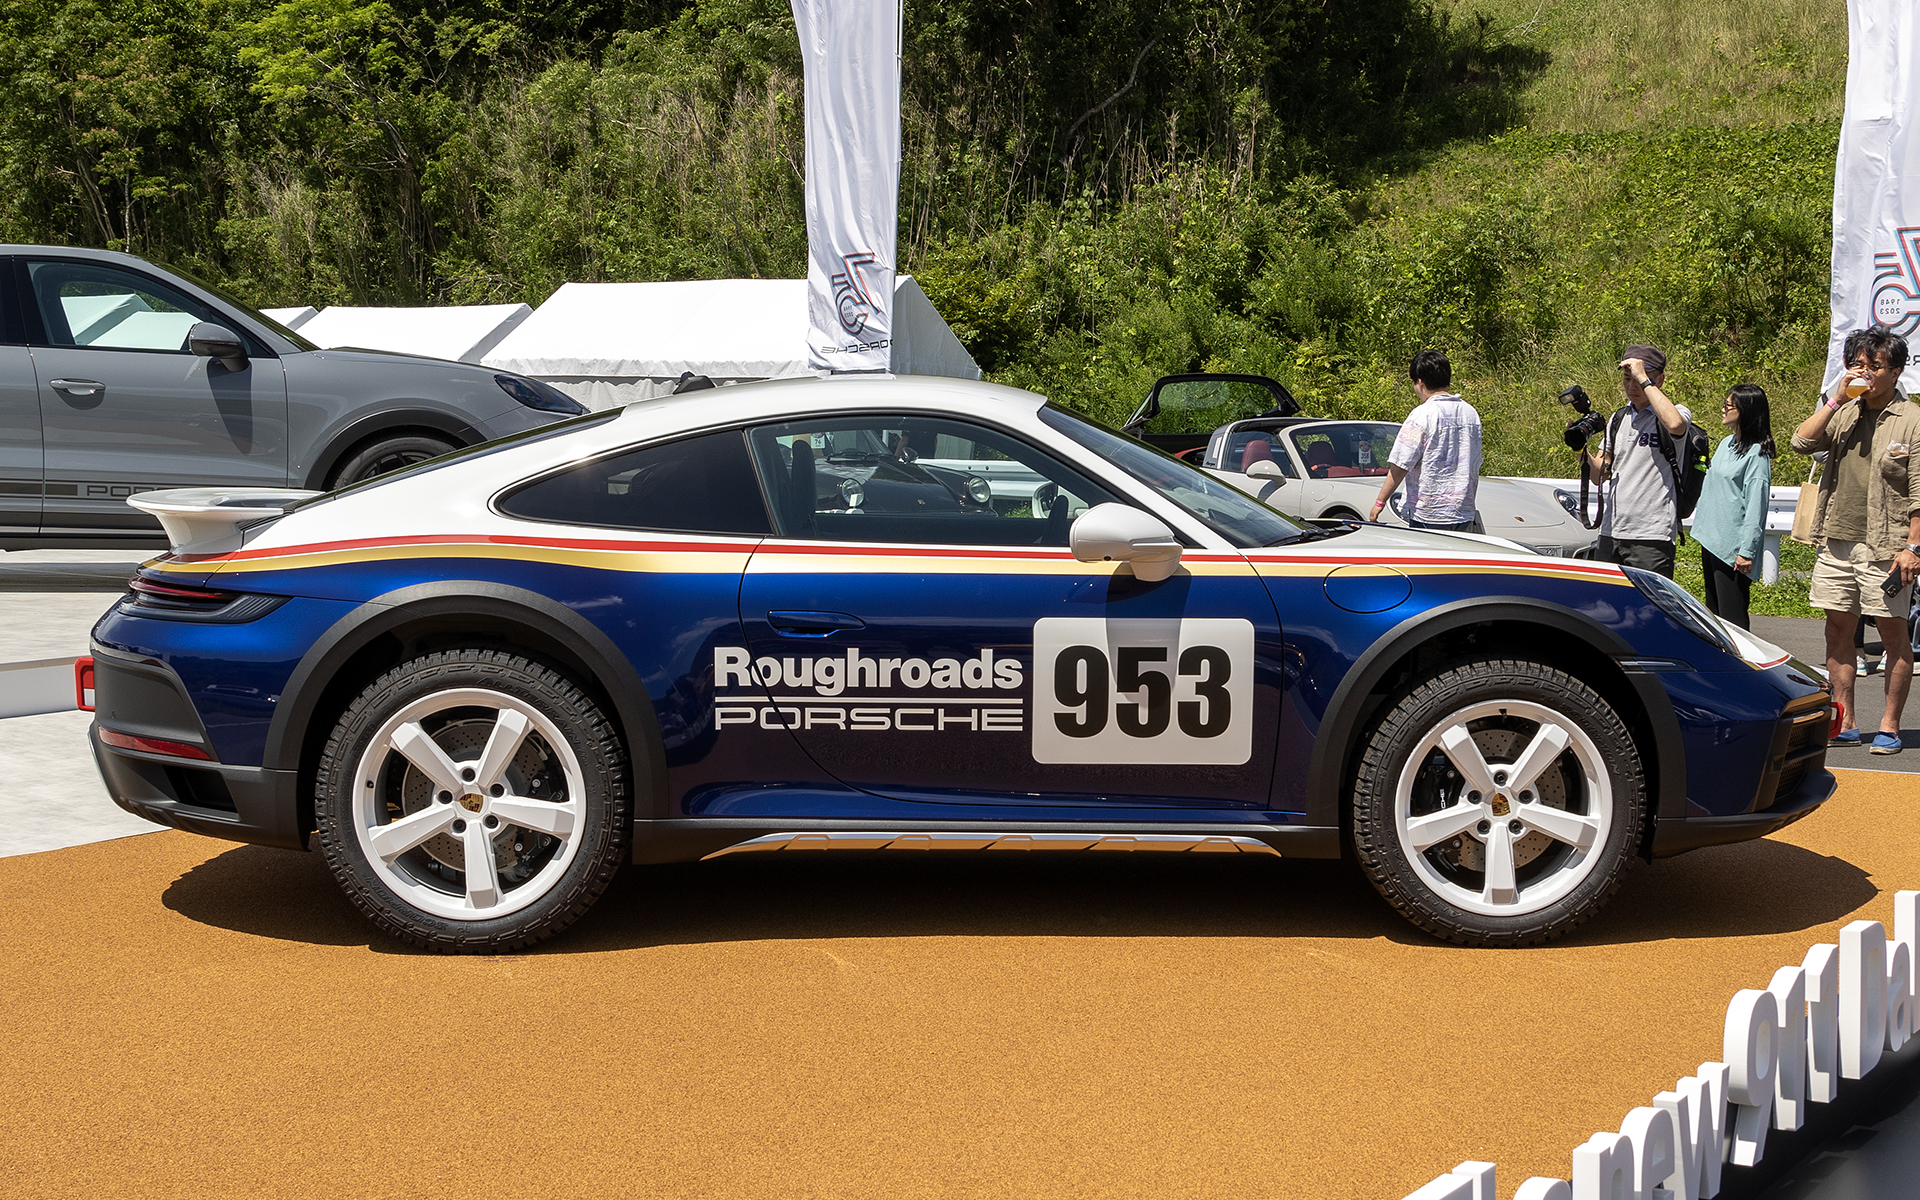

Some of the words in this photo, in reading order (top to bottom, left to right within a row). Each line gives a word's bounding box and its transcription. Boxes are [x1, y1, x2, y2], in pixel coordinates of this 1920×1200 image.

[713, 646, 1024, 697] Roughroads
[1052, 644, 1233, 739] 953
[714, 706, 1024, 732] PORSCHE
[1723, 943, 1839, 1167] 911
